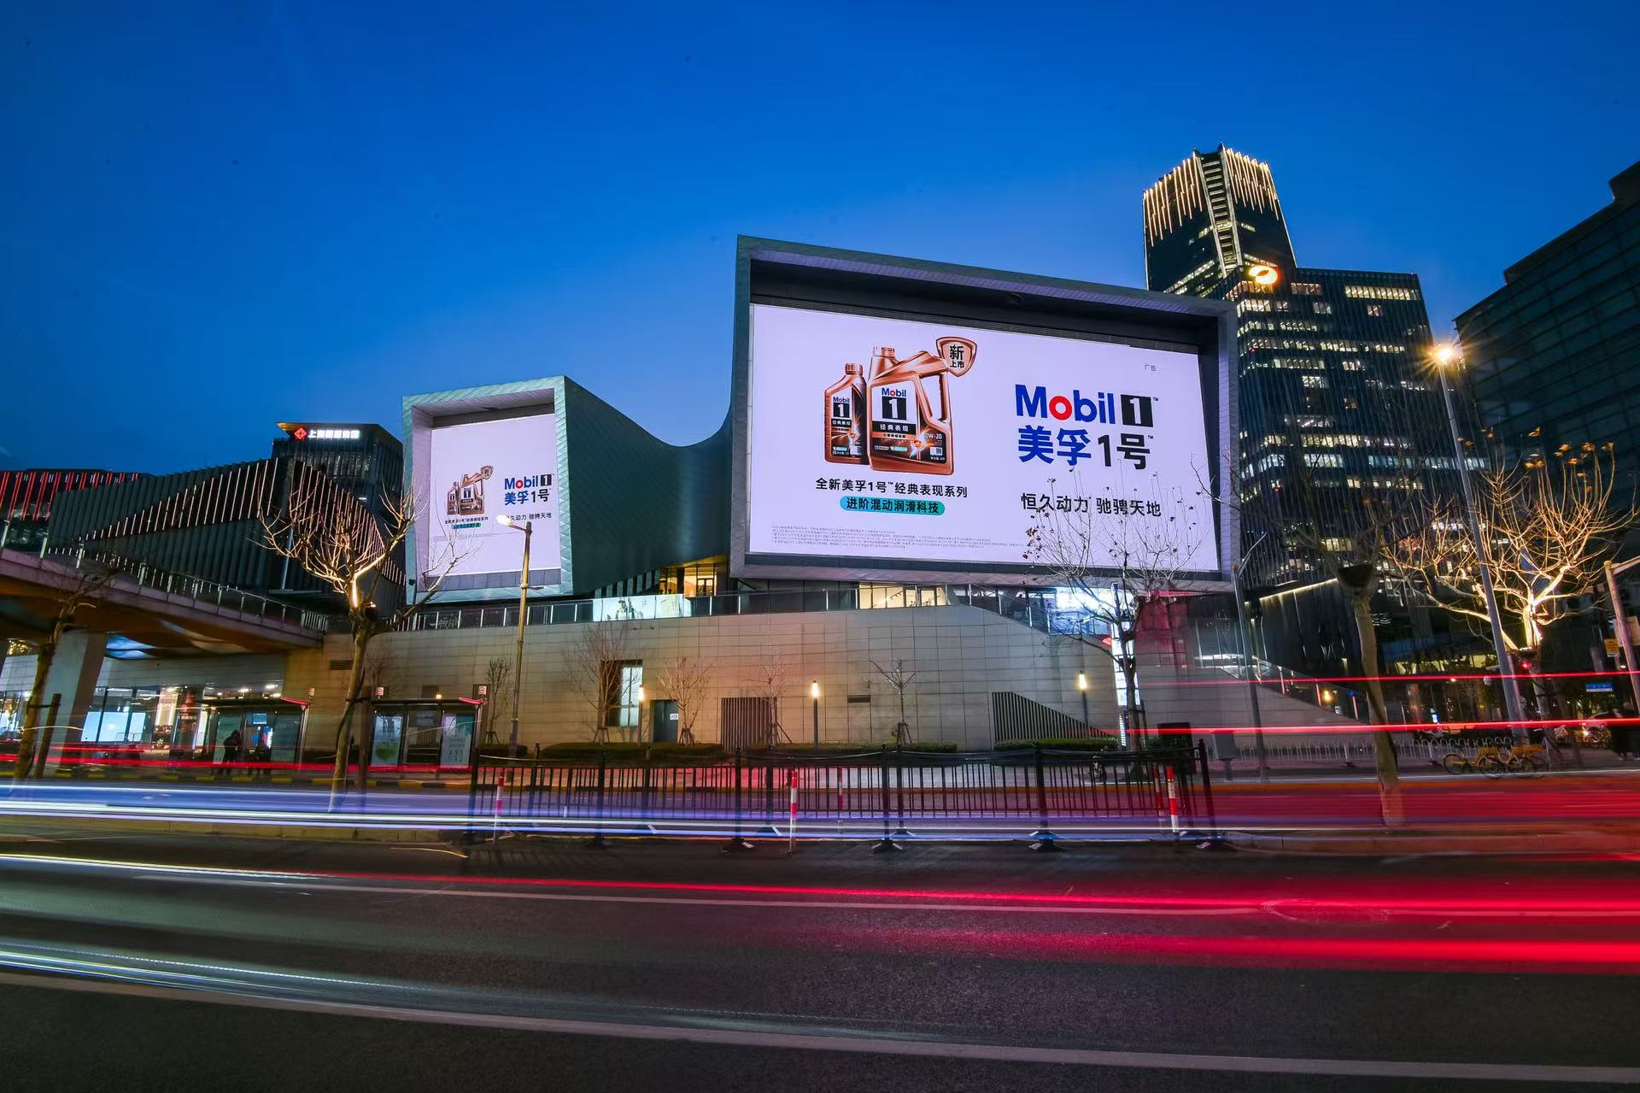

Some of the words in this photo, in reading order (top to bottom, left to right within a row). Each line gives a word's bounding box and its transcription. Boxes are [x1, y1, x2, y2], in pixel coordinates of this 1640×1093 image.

[950, 344, 965, 360] 新
[950, 361, 965, 369] 上市
[881, 387, 907, 397] Mobil
[1015, 384, 1116, 424] Mobil
[504, 475, 539, 490] Mobil
[846, 497, 939, 514] 进阶混动润滑科技
[506, 513, 527, 521] 久动力
